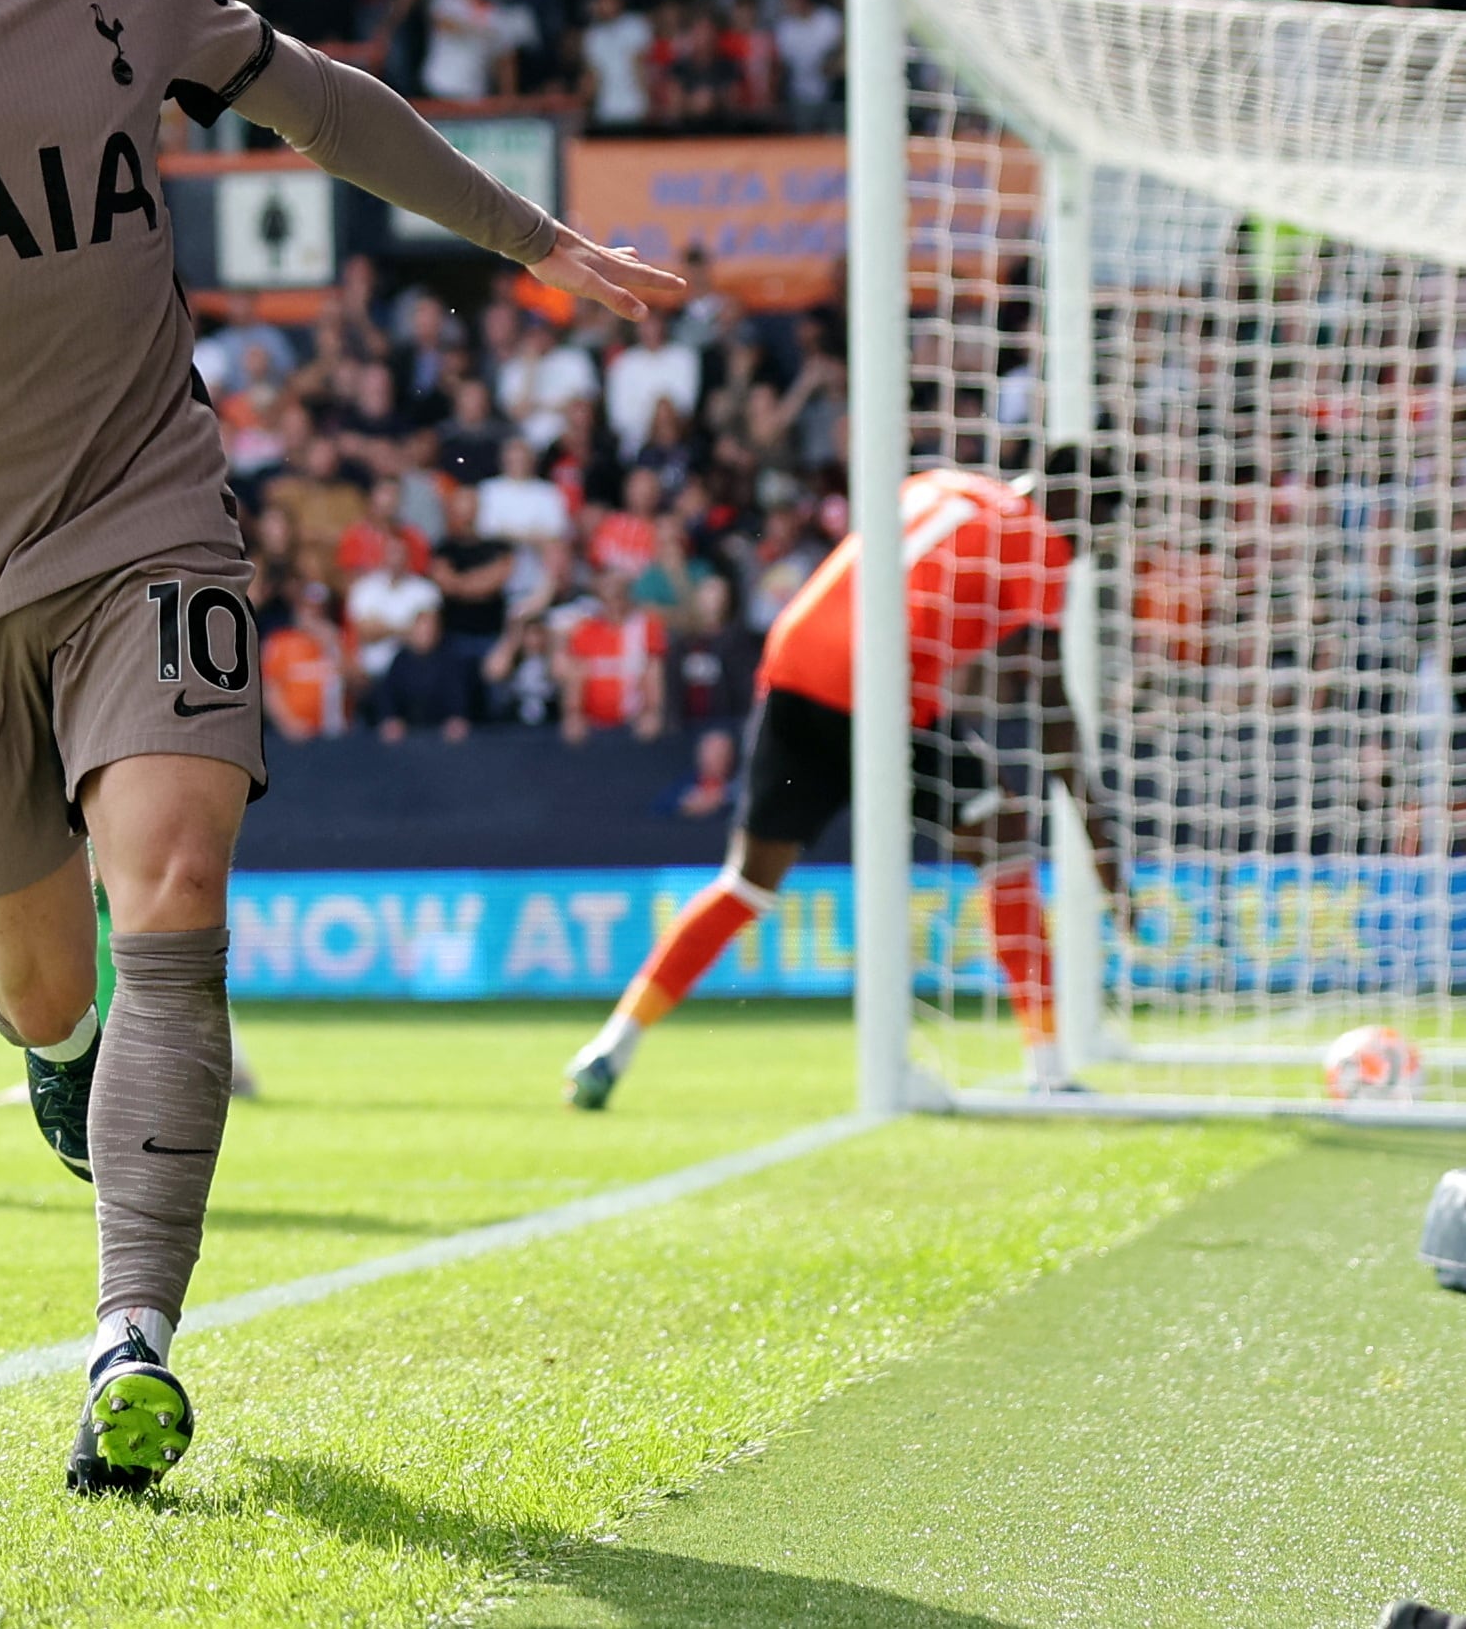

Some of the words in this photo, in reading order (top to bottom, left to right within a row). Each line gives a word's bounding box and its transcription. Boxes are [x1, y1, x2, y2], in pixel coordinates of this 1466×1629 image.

[147, 579, 250, 693] 10
[232, 892, 485, 982] NOW
[503, 892, 630, 981] AT
